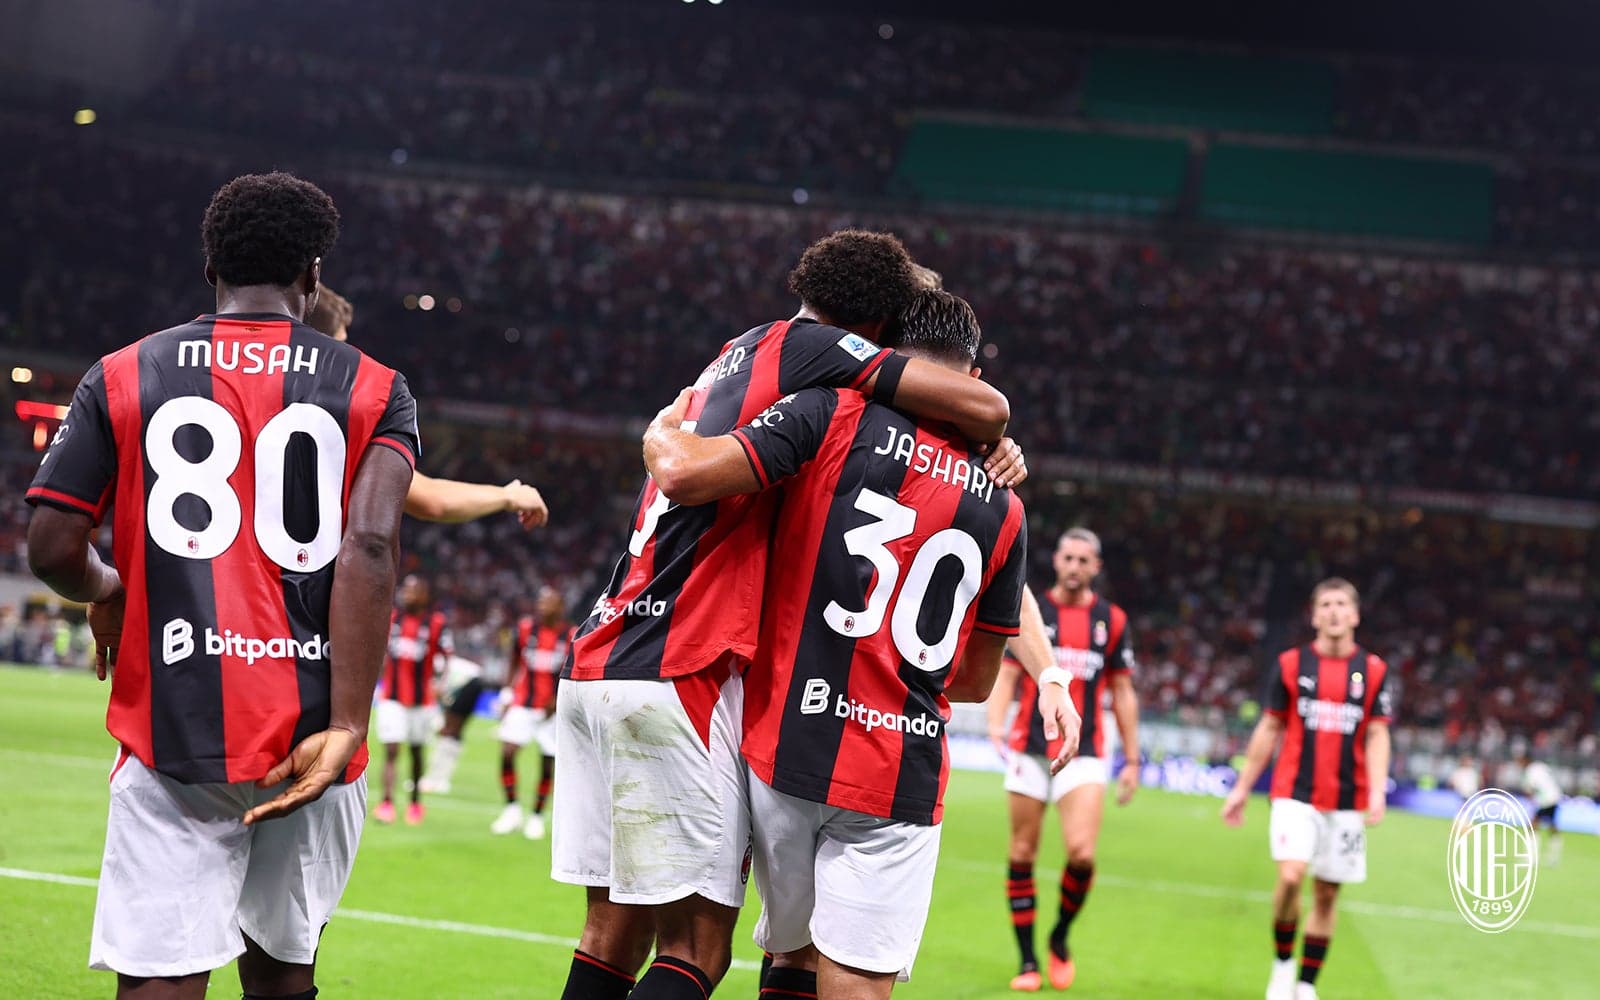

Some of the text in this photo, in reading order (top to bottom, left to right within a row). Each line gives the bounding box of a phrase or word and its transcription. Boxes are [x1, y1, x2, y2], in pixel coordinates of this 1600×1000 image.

[177, 340, 319, 375] MUSAH
[145, 396, 347, 573] 80
[874, 426, 994, 504] JASHARI
[823, 487, 983, 672] 30
[834, 694, 940, 738] bitpanda
